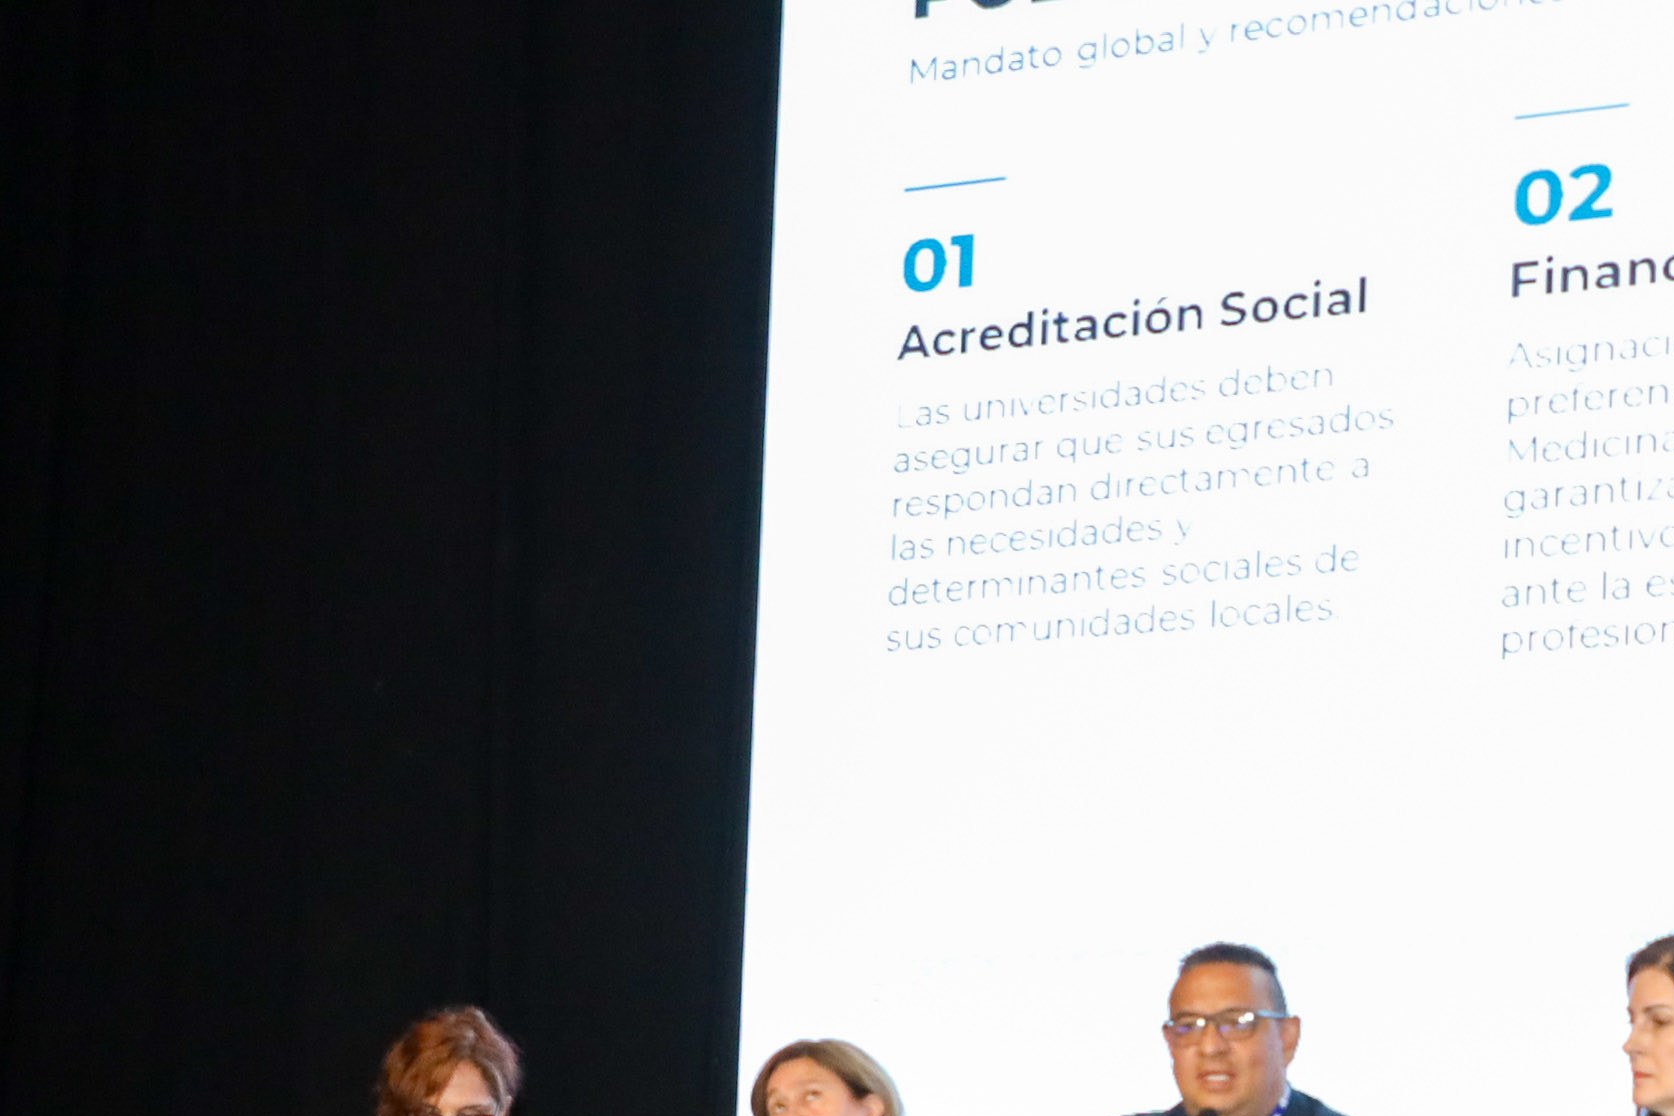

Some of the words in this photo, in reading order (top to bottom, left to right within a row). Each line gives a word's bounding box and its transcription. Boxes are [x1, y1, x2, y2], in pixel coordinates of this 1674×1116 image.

[910, 45, 1062, 84] Mandato
[1077, 22, 1184, 69] global
[1198, 28, 1215, 54] y
[1513, 161, 1615, 227] 02
[902, 232, 976, 293] 01
[896, 296, 1204, 361] Acreditación
[1219, 275, 1368, 328] Social
[898, 404, 950, 428] Las
[964, 376, 1206, 421] universidades
[1219, 365, 1332, 397] deben
[893, 440, 1043, 475] asegurar
[1057, 434, 1122, 463] que
[1137, 427, 1194, 451] sus
[1206, 404, 1394, 450] egresados
[893, 479, 1076, 520] respondan
[1090, 458, 1334, 501] directamente
[1352, 458, 1369, 478] a
[891, 534, 935, 561] las
[948, 516, 1162, 556] necesidades
[1174, 520, 1190, 545] y
[888, 565, 1146, 606] determinantes
[1162, 550, 1302, 586] sociales
[1315, 544, 1359, 574] de
[1502, 578, 1586, 608] ante
[1602, 571, 1630, 600] la
[887, 627, 942, 652] sus
[954, 605, 1195, 647] comunidades
